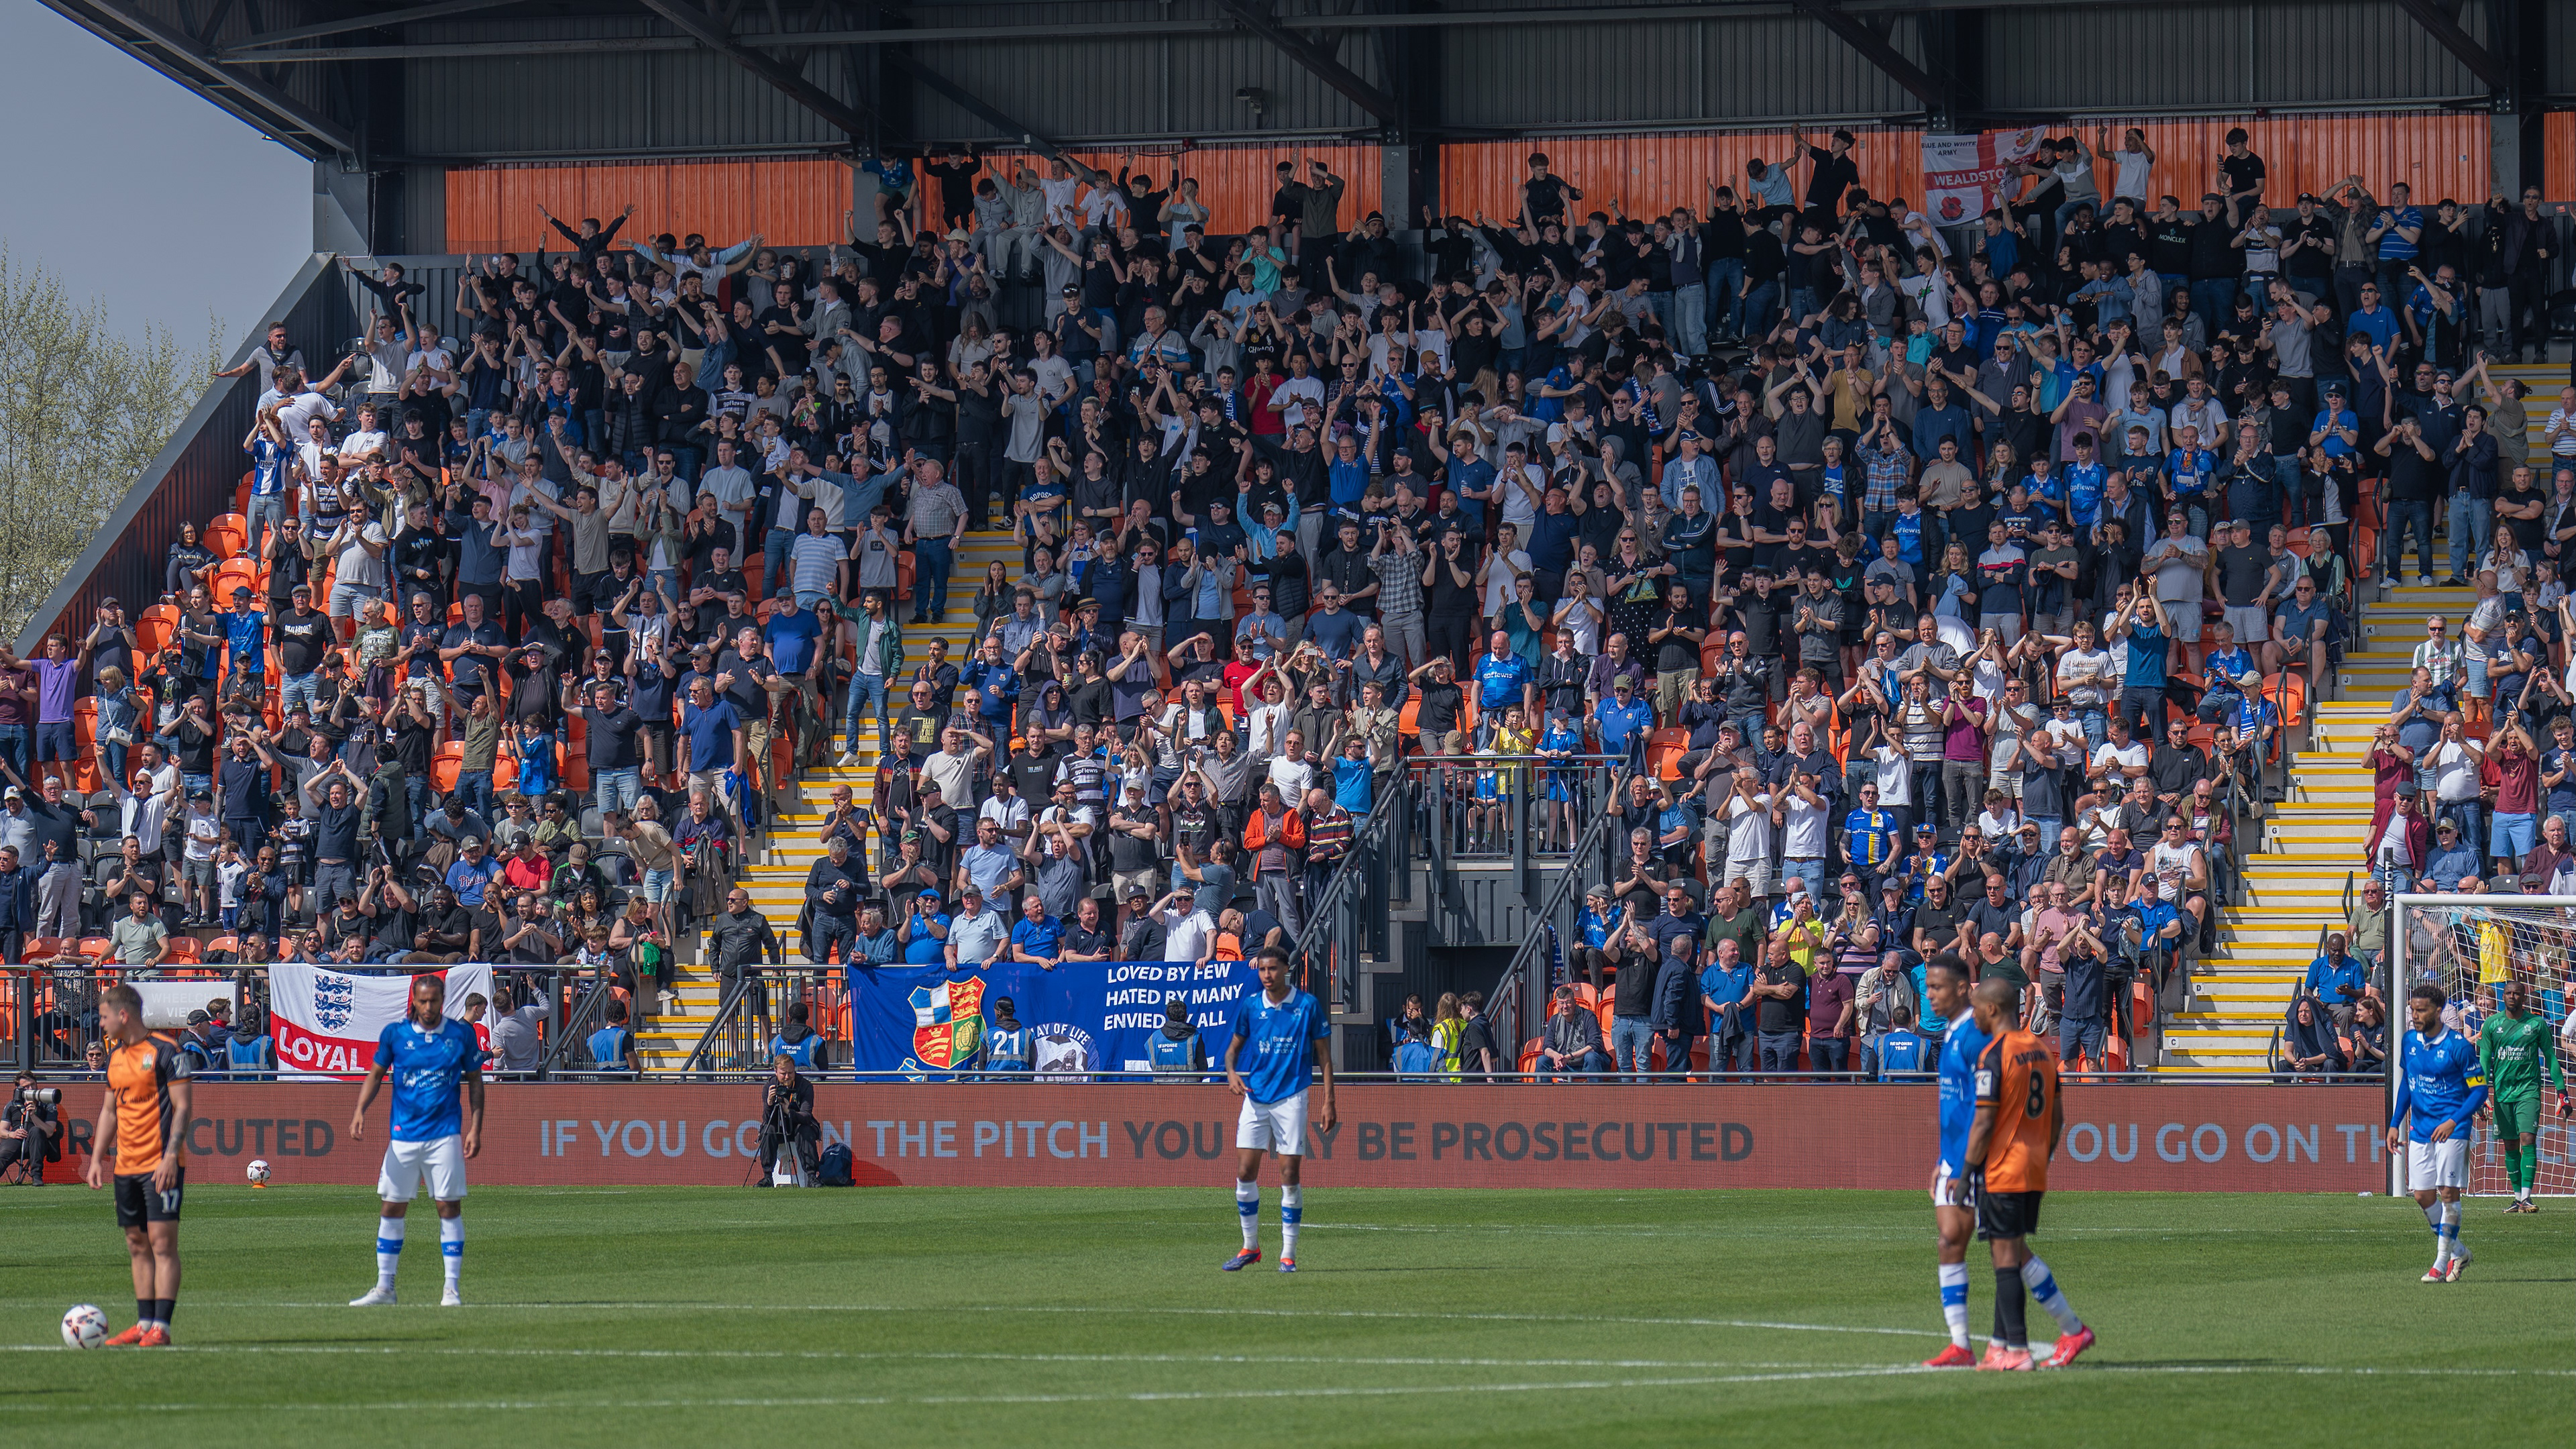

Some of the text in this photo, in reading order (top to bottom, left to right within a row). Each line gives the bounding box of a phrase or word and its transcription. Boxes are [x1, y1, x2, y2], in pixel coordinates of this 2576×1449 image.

[2158, 233, 2186, 243] MONCLER
[2070, 484, 2096, 492] gpflewis
[1483, 671, 1513, 680] gpflewis
[1075, 767, 1098, 775] gpflewis
[2385, 861, 2394, 911] FORZA
[1108, 962, 1232, 983] LOVED BY FEW
[1106, 983, 1244, 1006] HATED BY MANY
[1104, 1012, 1167, 1031] ENVIED
[1196, 1010, 1226, 1028] ALL
[994, 1030, 1020, 1055] 21
[1031, 1023, 1091, 1045] AY OF LIFE
[279, 1026, 365, 1071] LOYAL
[2026, 1067, 2046, 1120] 8
[68, 1118, 334, 1157] RCUTED
[541, 1120, 578, 1157] IF
[591, 1120, 687, 1158] YOU
[702, 1120, 763, 1158] GO
[822, 1120, 853, 1152] N
[867, 1121, 958, 1158] THE
[974, 1120, 1109, 1159] PITCH
[1123, 1121, 1224, 1160] YOU
[1357, 1122, 1416, 1161] BE
[1432, 1122, 1754, 1162] PROSECUTED
[2061, 1122, 2138, 1163] OU
[2155, 1122, 2229, 1163] GO
[2245, 1122, 2320, 1163] ON
[160, 1188, 180, 1214] 17
